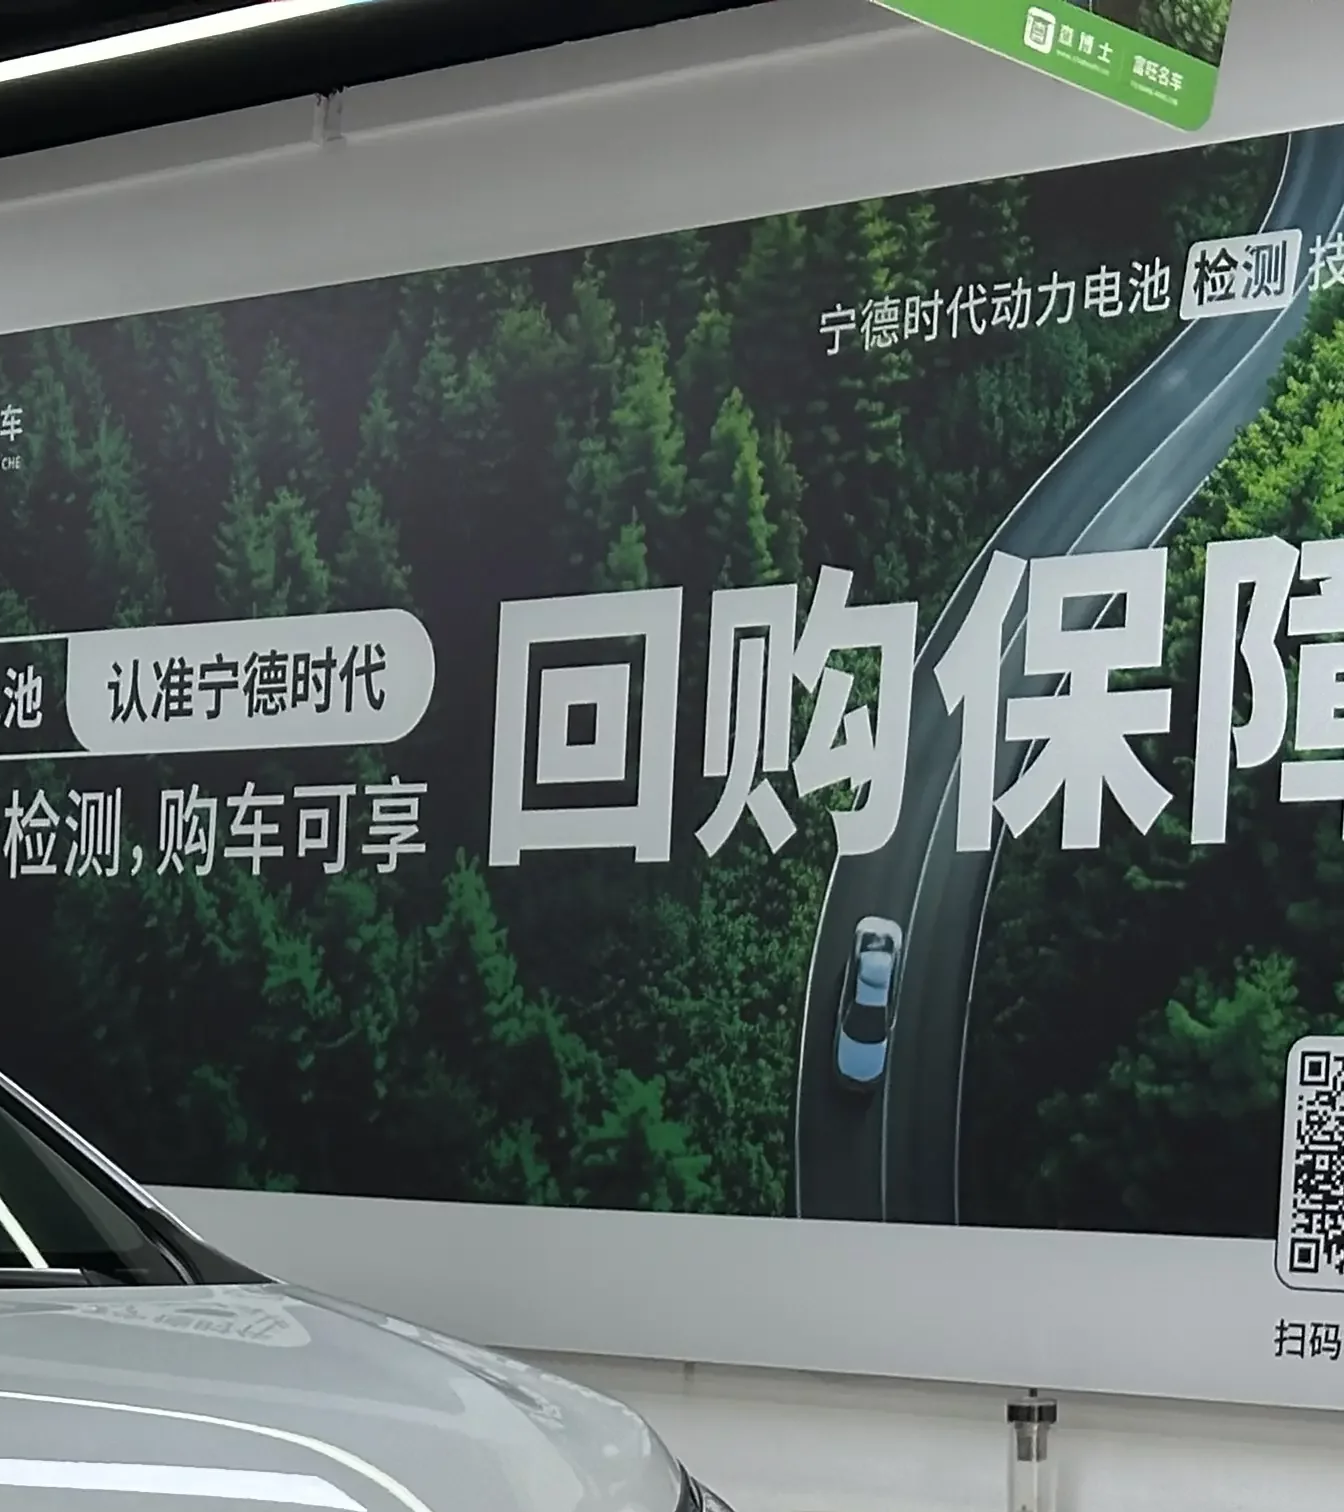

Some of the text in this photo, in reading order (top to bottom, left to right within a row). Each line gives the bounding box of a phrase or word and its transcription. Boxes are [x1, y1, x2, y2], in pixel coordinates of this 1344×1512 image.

[1059, 24, 1113, 63] 查博士
[1132, 54, 1184, 91] 富旺名车
[819, 256, 1172, 356] 宁德时代动力电池
[1, 455, 22, 471] CHE
[107, 643, 388, 724] 认准宁德时代
[1274, 1318, 1342, 1361] 扫码
